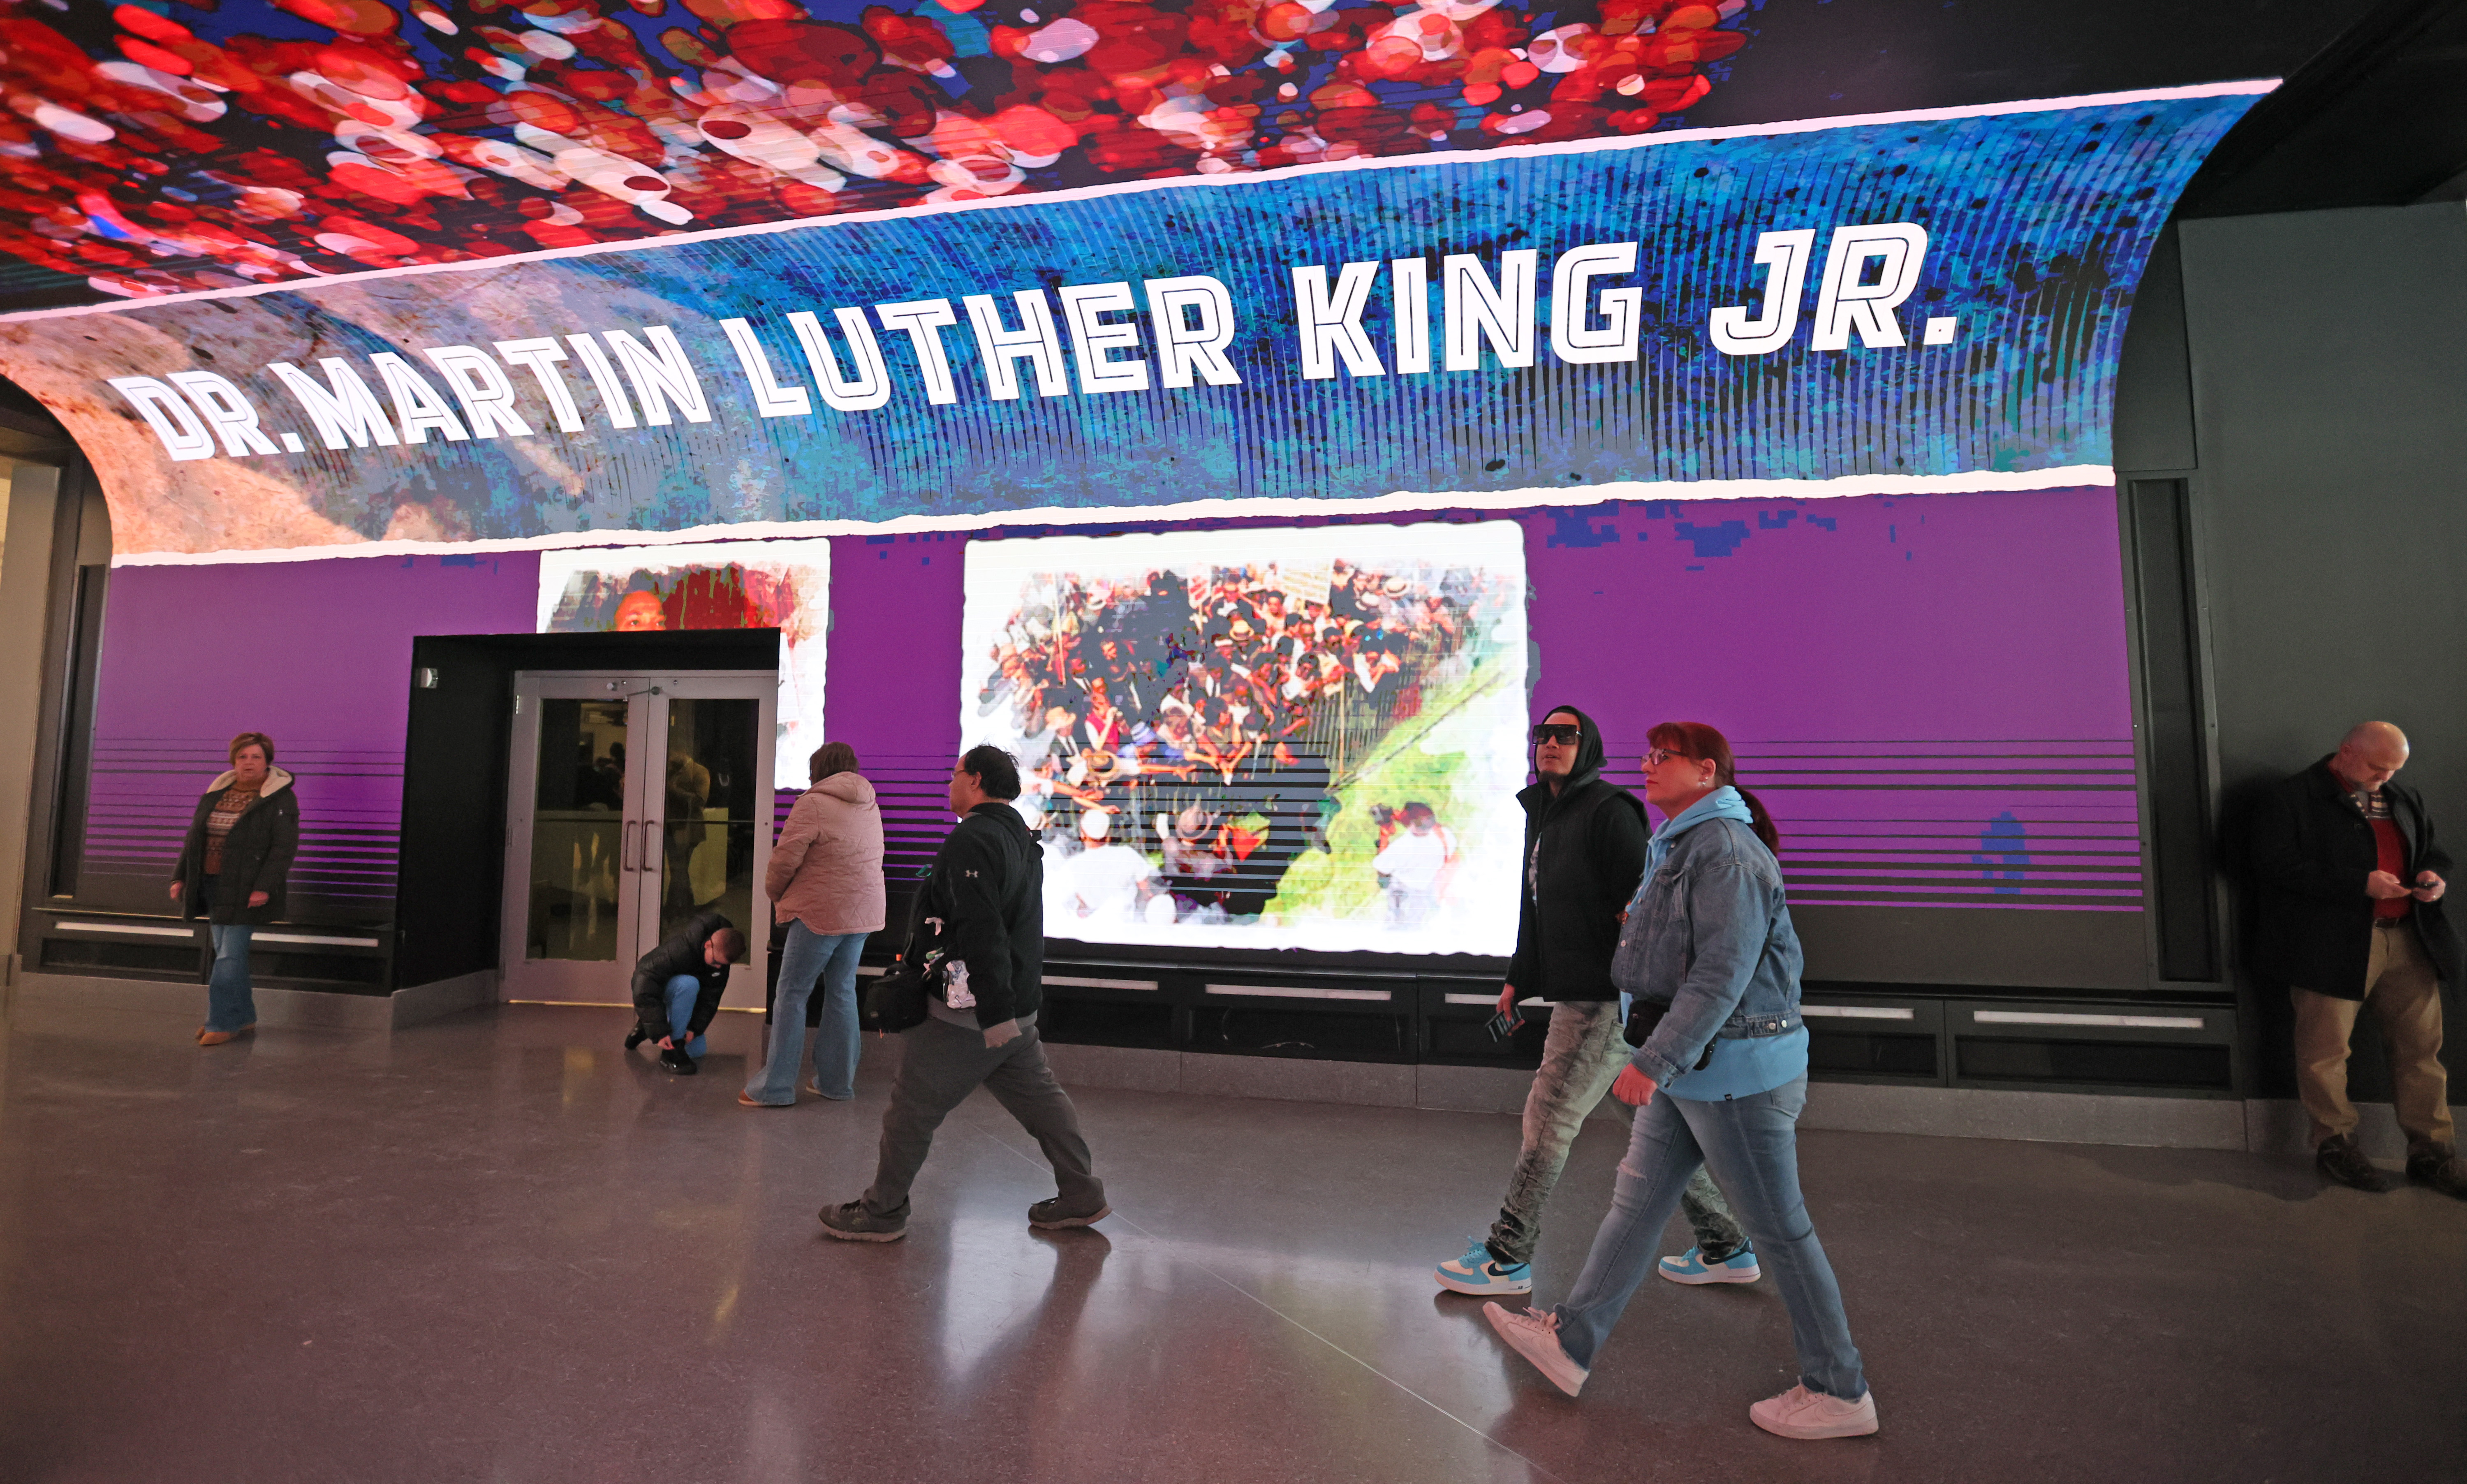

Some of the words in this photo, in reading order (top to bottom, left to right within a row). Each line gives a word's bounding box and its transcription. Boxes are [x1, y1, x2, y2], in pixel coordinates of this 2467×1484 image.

[719, 275, 1243, 418] LUTHER
[1292, 241, 1643, 380] KING
[1710, 222, 1957, 355] JR.
